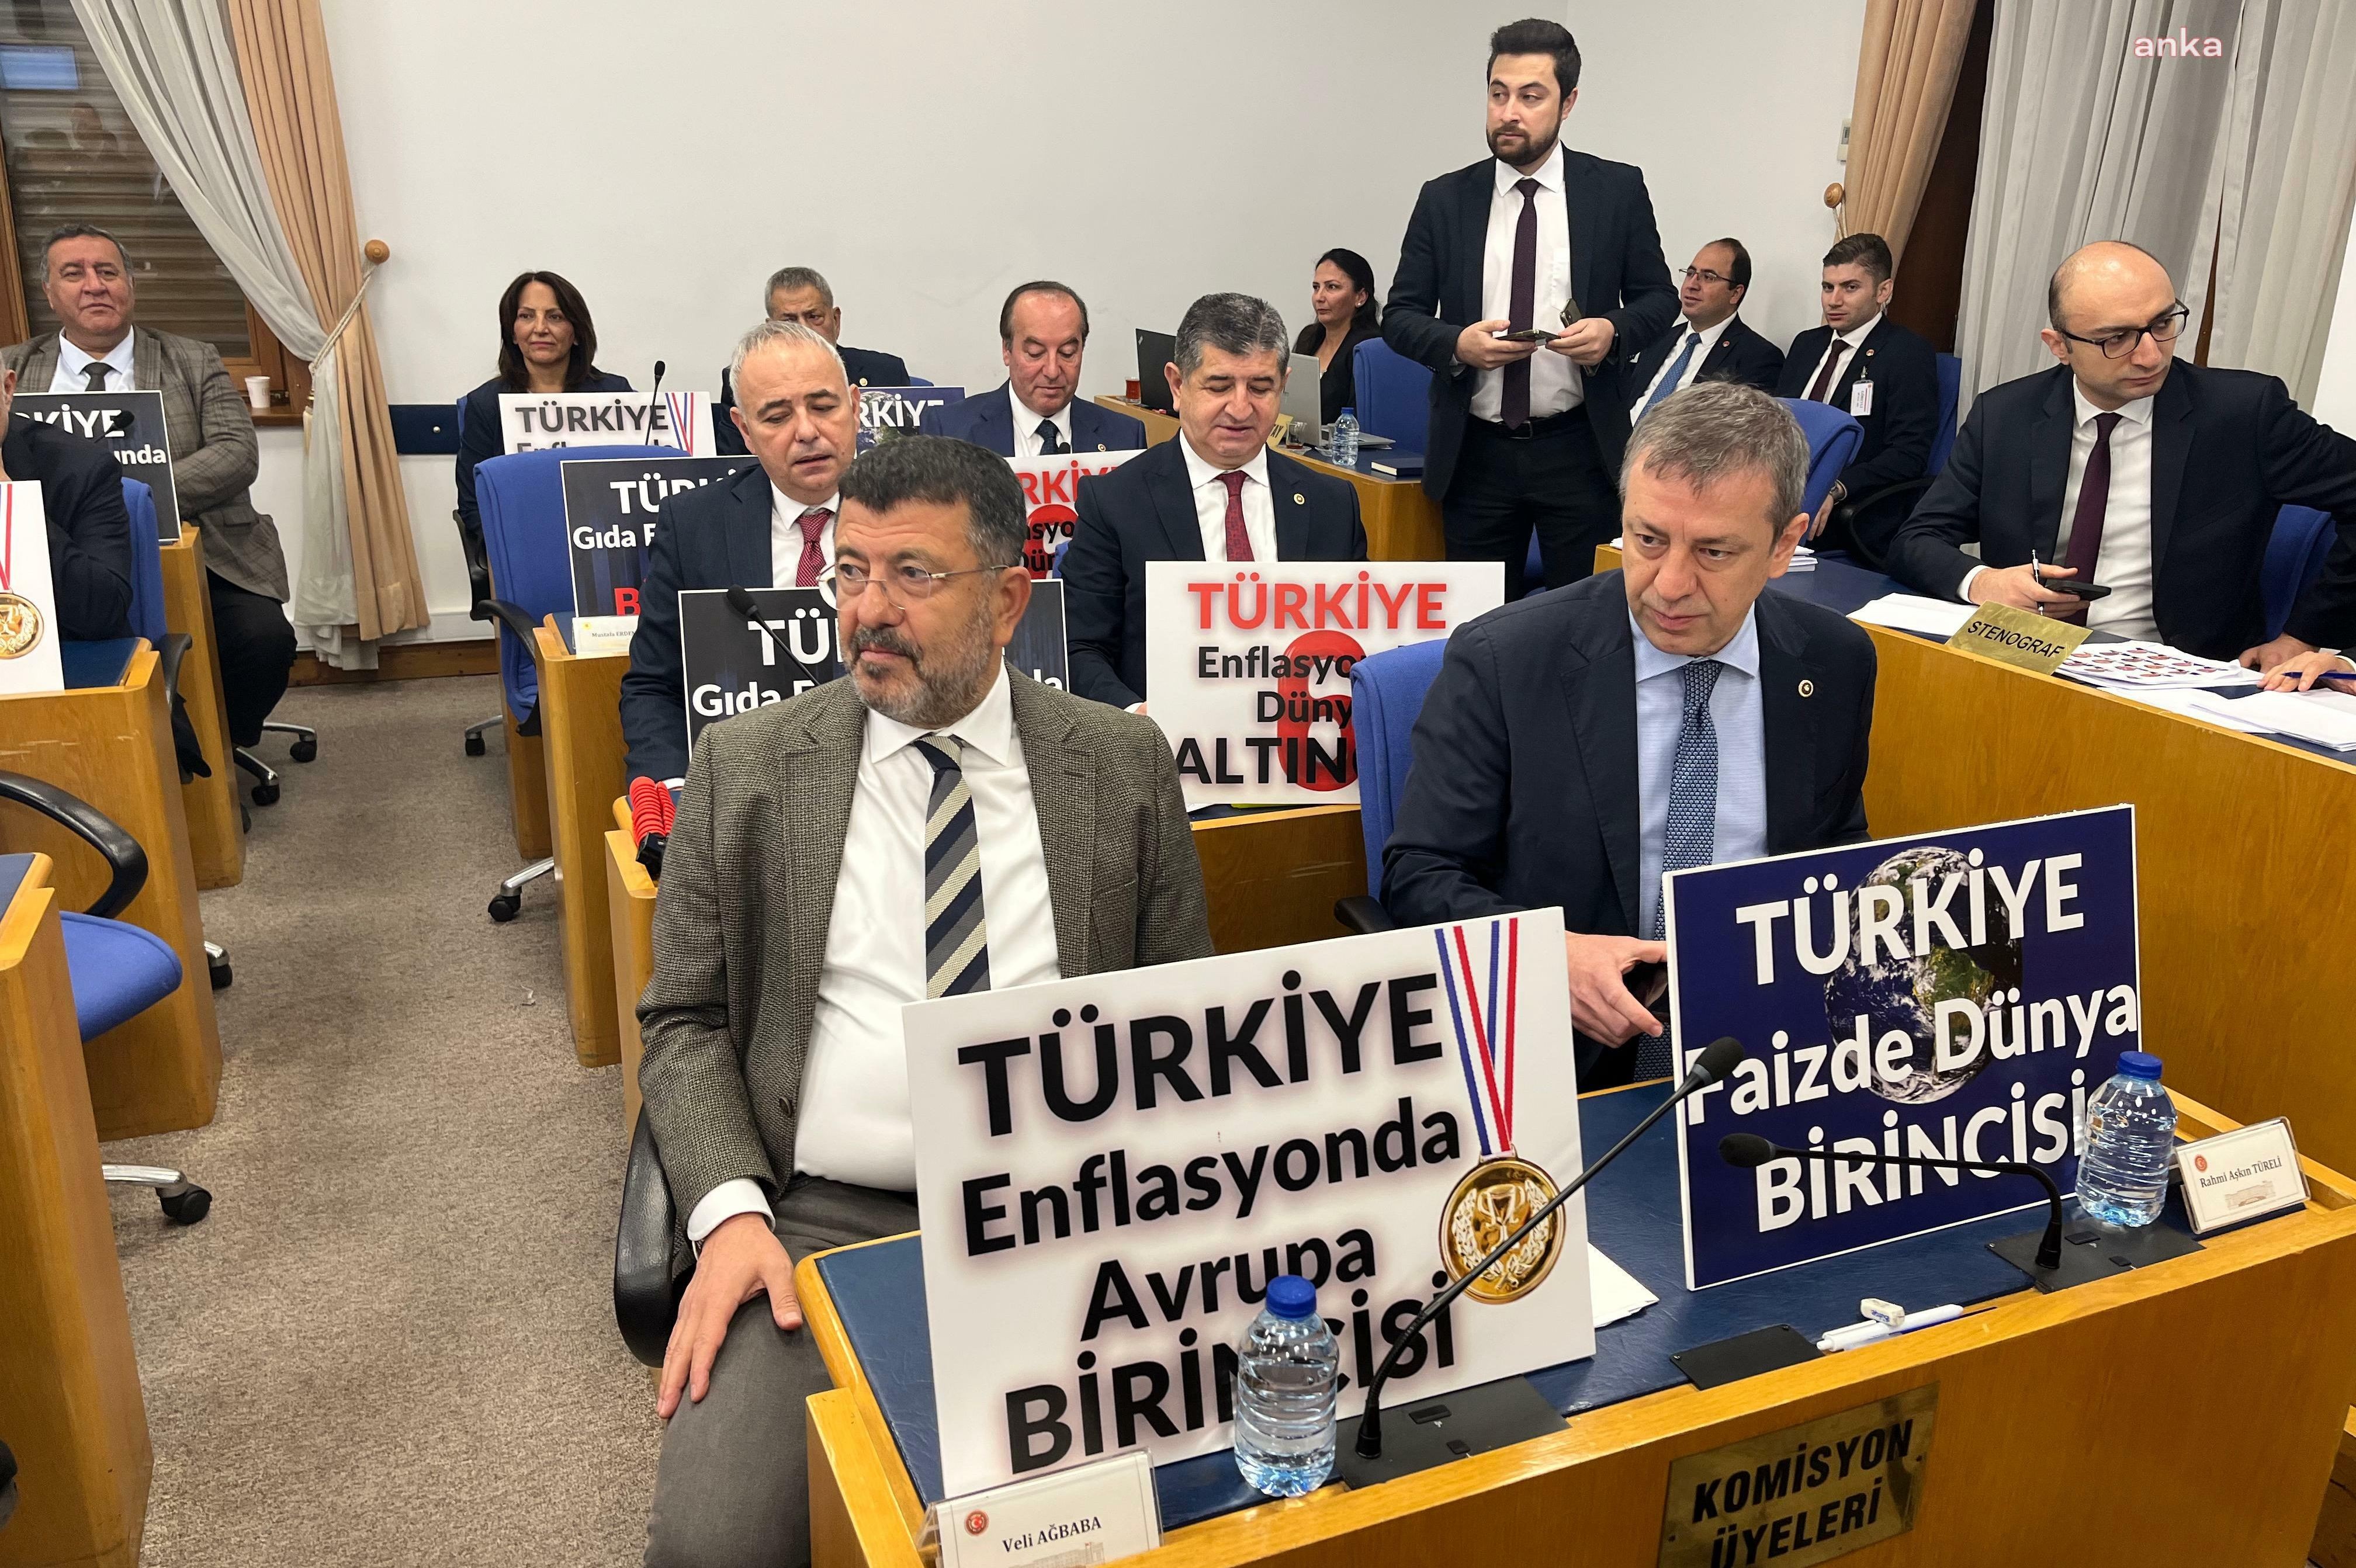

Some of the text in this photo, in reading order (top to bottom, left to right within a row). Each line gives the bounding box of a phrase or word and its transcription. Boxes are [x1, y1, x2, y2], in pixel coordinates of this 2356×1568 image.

[515, 398, 669, 433] TÜRKİYE
[573, 524, 637, 550] Gıda
[1187, 571, 1447, 630] TÜRKİYE
[1198, 645, 1368, 685] Enflasyo
[1967, 620, 2065, 658] STENOGRAF
[1175, 737, 1359, 785] ALTIN
[1735, 848, 2085, 986] TÜRKİYE
[957, 970, 1444, 1137] TÜRKİYE
[1934, 983, 2138, 1073] Dünya
[961, 1096, 1462, 1257] Enflasyonda
[2199, 1156, 2282, 1188] Rahmi Aşkın TÜRELİ
[1080, 1227, 1377, 1342] Avrupa
[1692, 1418, 1914, 1524] KOMİSYON
[1002, 1516, 1102, 1553] Veli AĞBABA
[1710, 1476, 1883, 1568] ÜYELERİ
